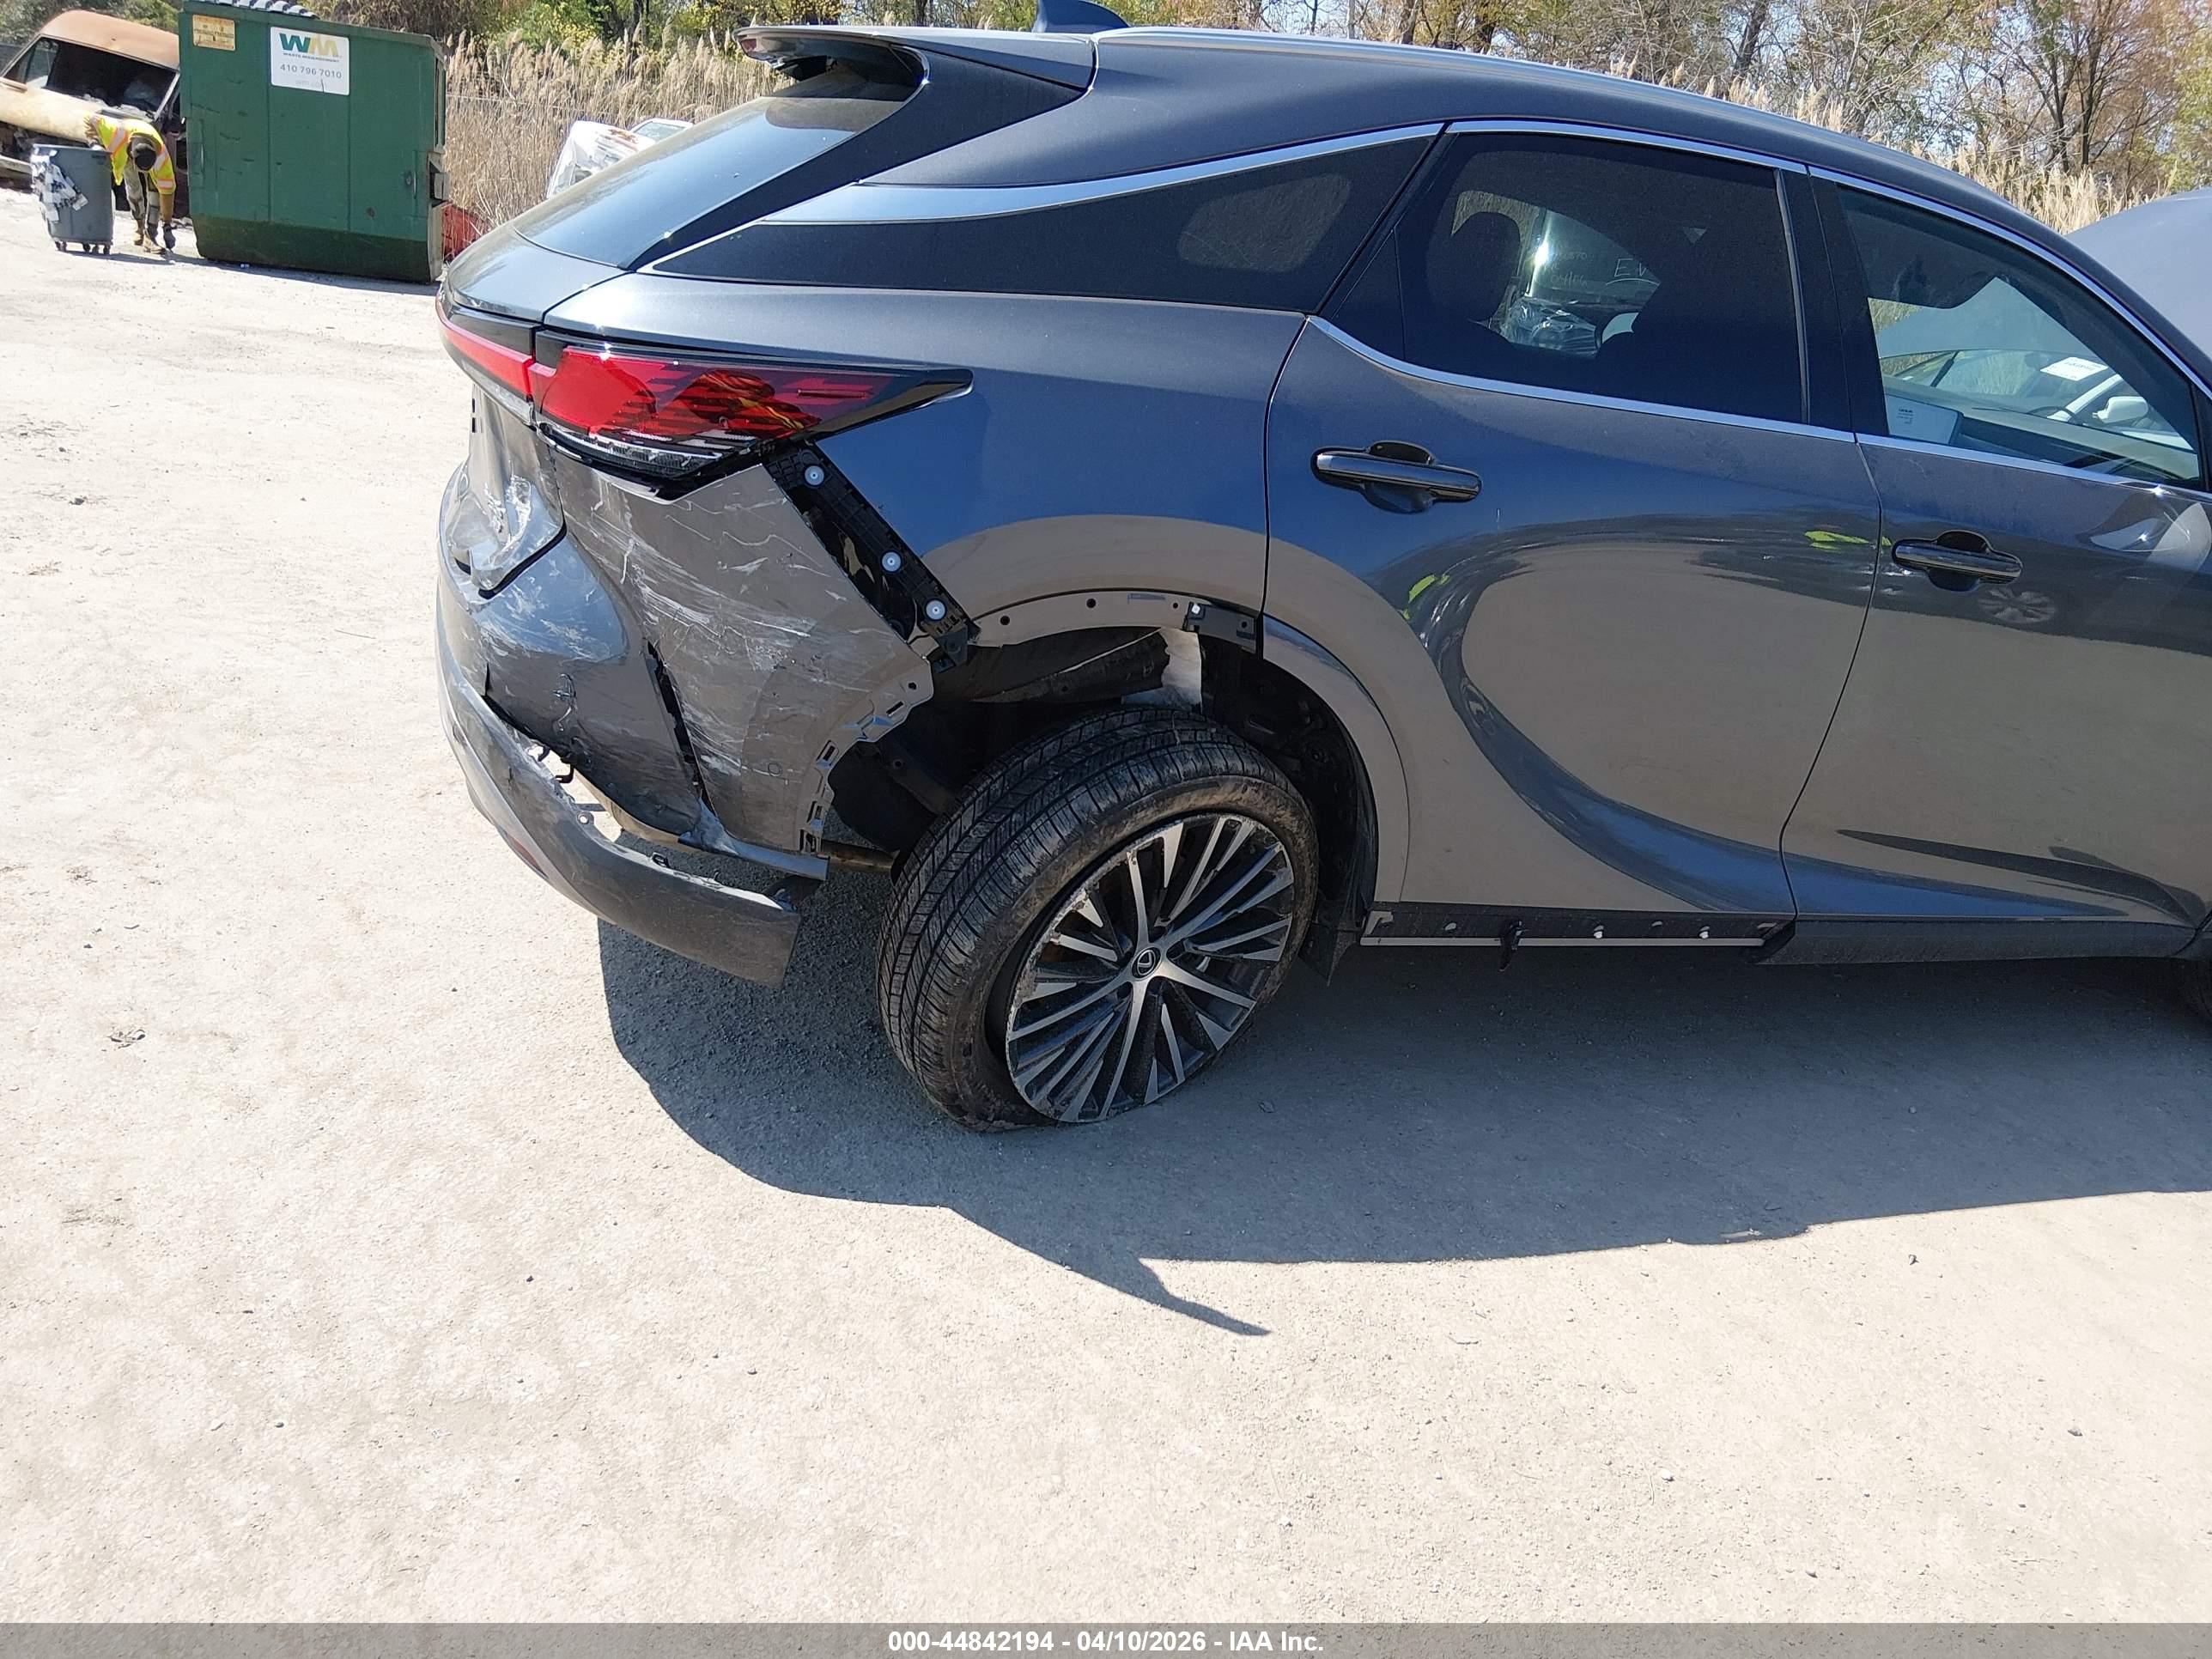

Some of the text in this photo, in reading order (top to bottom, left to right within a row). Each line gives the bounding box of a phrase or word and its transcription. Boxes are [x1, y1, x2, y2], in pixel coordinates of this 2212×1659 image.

[279, 33, 338, 56] WM
[280, 64, 342, 79] 410 796 7010
